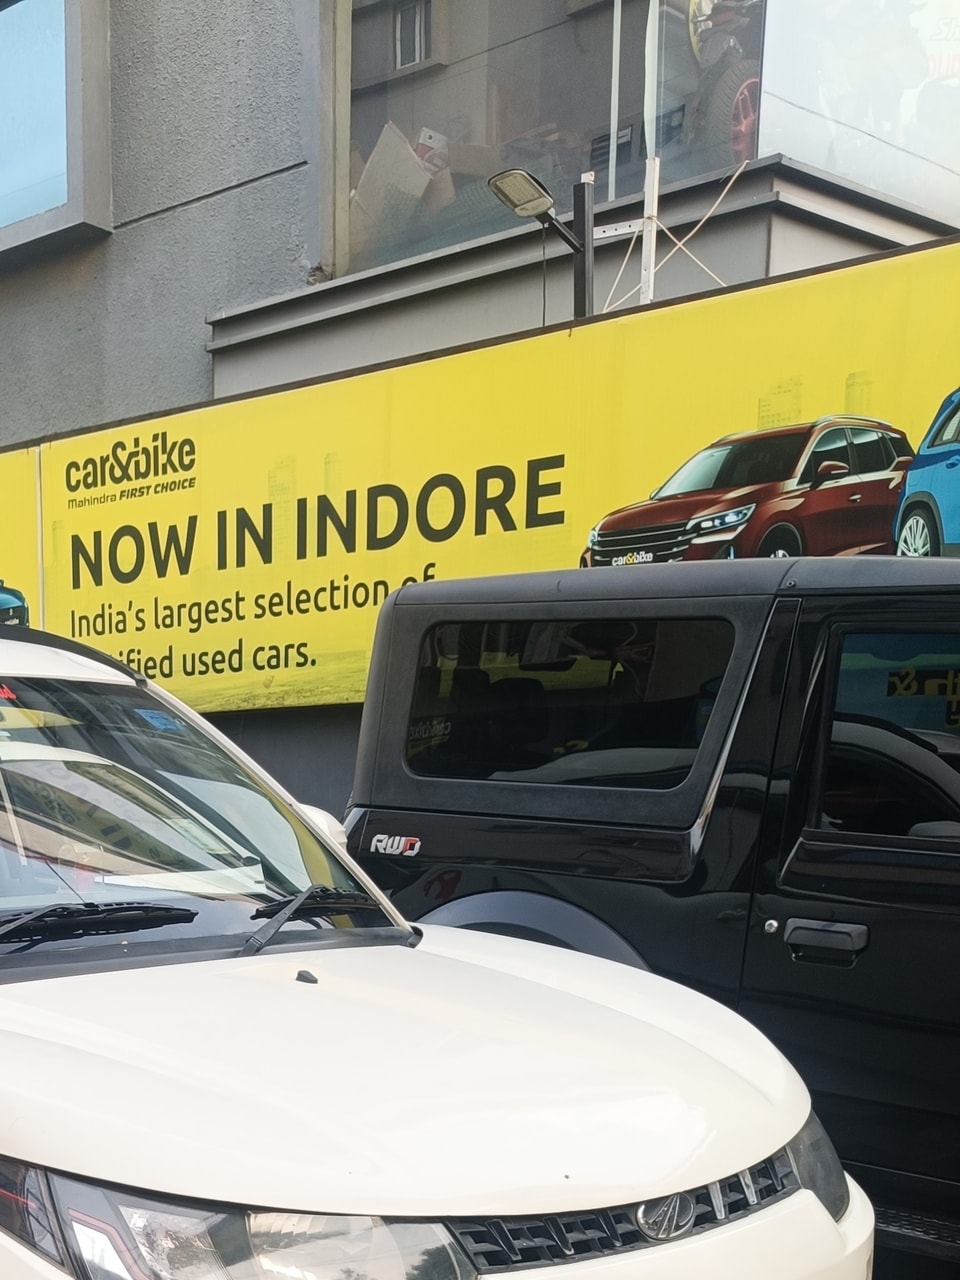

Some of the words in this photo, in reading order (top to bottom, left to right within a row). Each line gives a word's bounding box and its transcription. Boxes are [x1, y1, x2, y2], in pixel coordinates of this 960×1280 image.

[65, 431, 196, 492] car&bike
[68, 493, 117, 509] Mahindra
[119, 485, 152, 501] FIRST
[153, 477, 196, 494] CHOICE
[71, 515, 198, 590] NOW
[217, 503, 273, 571] IN
[296, 454, 565, 561] INDORE
[611, 551, 654, 566] car&bike
[154, 591, 246, 634] largest
[253, 574, 389, 620] selection
[182, 638, 243, 677] used
[252, 641, 317, 672] cars.
[370, 834, 421, 857] RWD
